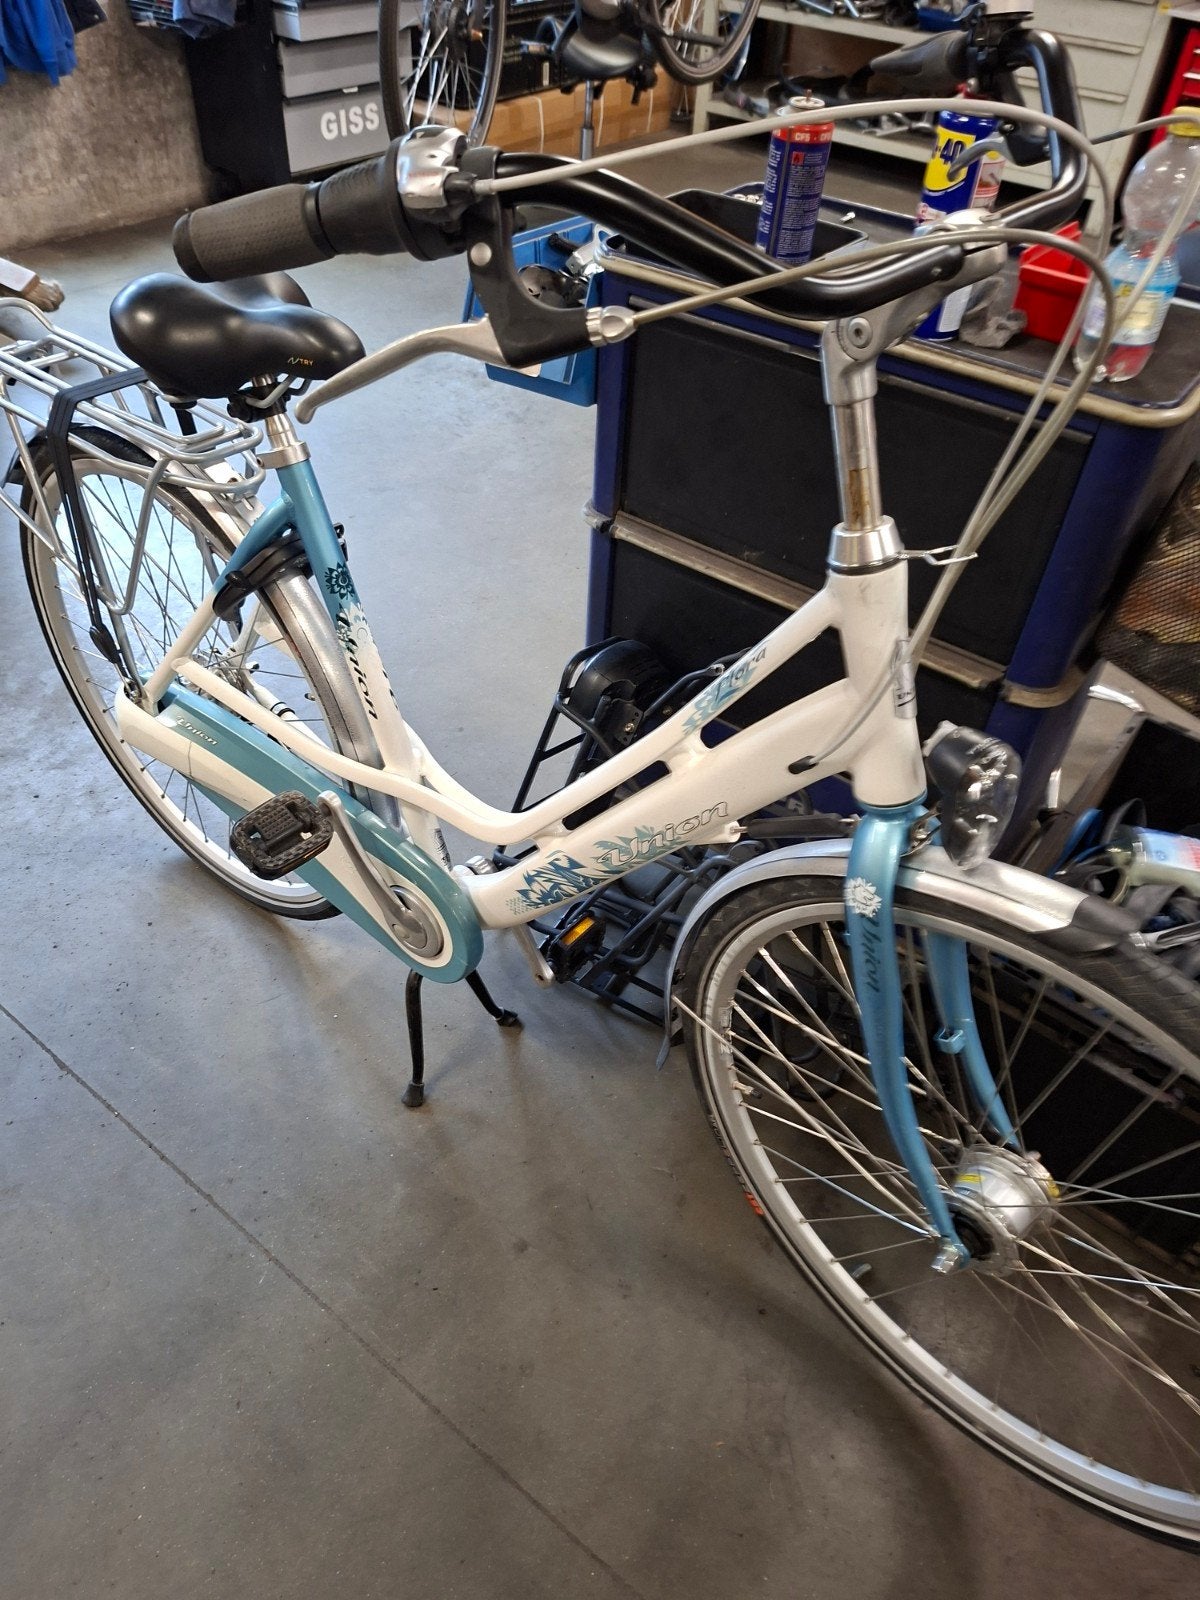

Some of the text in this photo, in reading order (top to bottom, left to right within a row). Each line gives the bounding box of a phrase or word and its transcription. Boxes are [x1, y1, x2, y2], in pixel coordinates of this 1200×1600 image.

[321, 102, 380, 141] GISS
[176, 716, 218, 746] Union
[597, 801, 728, 867] Union
[859, 913, 883, 993] Union
